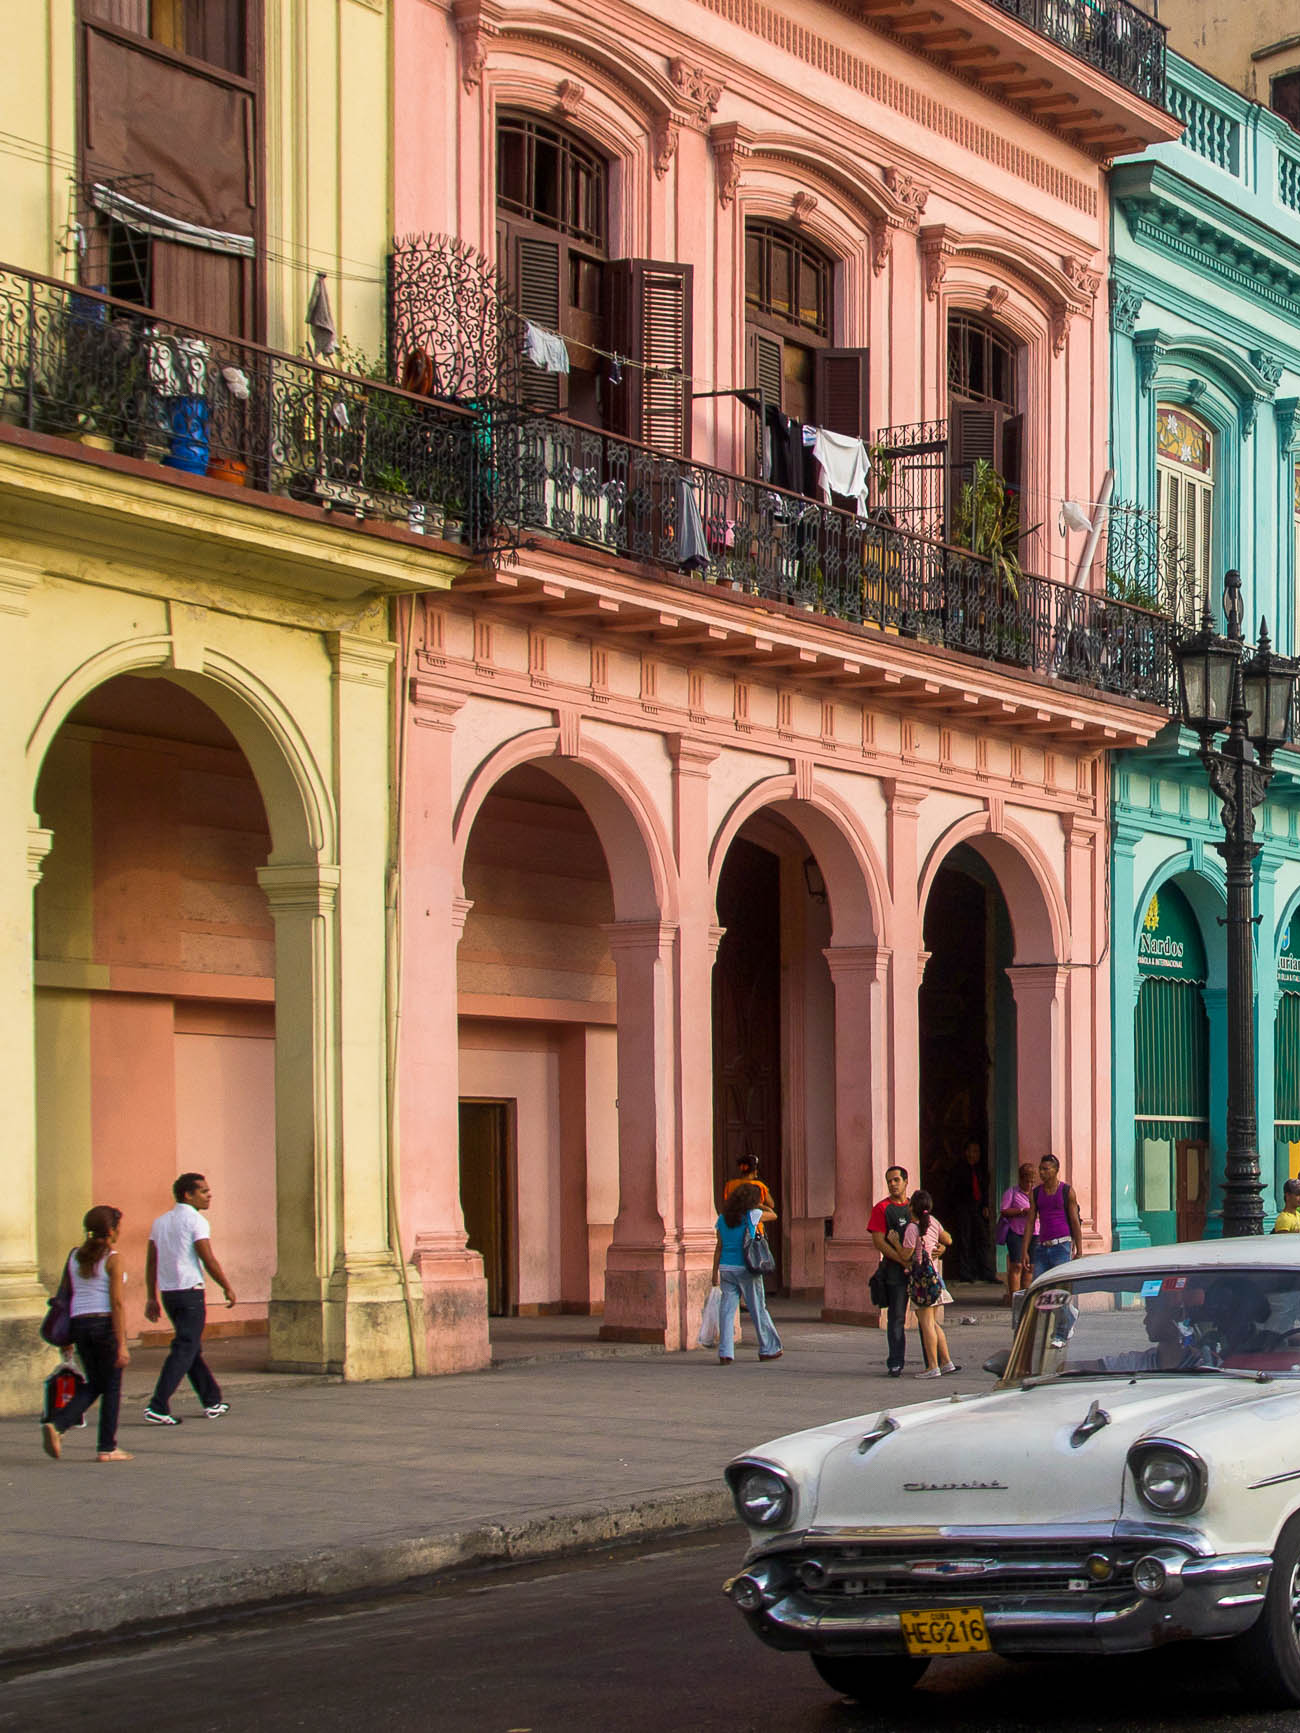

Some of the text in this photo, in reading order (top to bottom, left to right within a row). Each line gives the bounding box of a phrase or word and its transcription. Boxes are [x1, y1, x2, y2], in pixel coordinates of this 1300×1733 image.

[1140, 932, 1184, 957] Nardos
[1037, 1293, 1069, 1305] TAXI
[903, 1619, 985, 1644] HEG216
